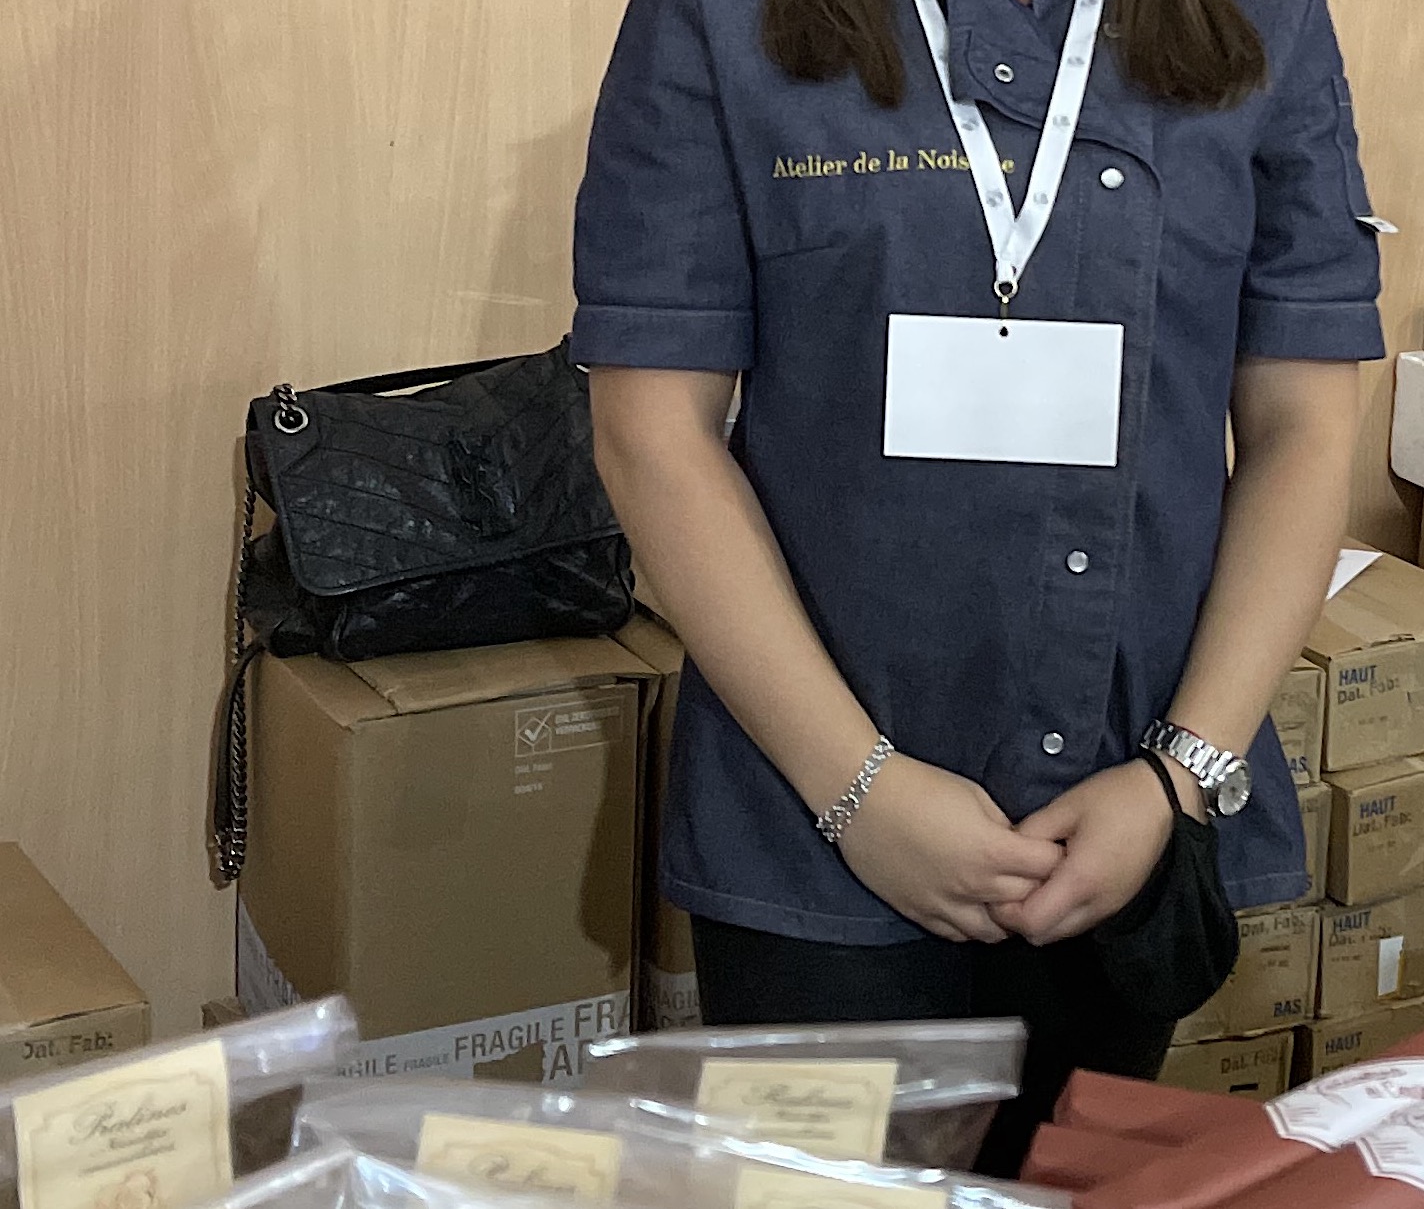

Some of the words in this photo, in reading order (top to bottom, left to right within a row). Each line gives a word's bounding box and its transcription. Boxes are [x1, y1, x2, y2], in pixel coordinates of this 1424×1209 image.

[773, 154, 848, 179] Atelier
[853, 151, 882, 174] de
[886, 149, 909, 172] la
[917, 148, 1015, 174] Noise
[1339, 664, 1378, 686] HAUT
[1360, 795, 1397, 819] HAUT
[454, 1015, 565, 1063] FRAGILE
